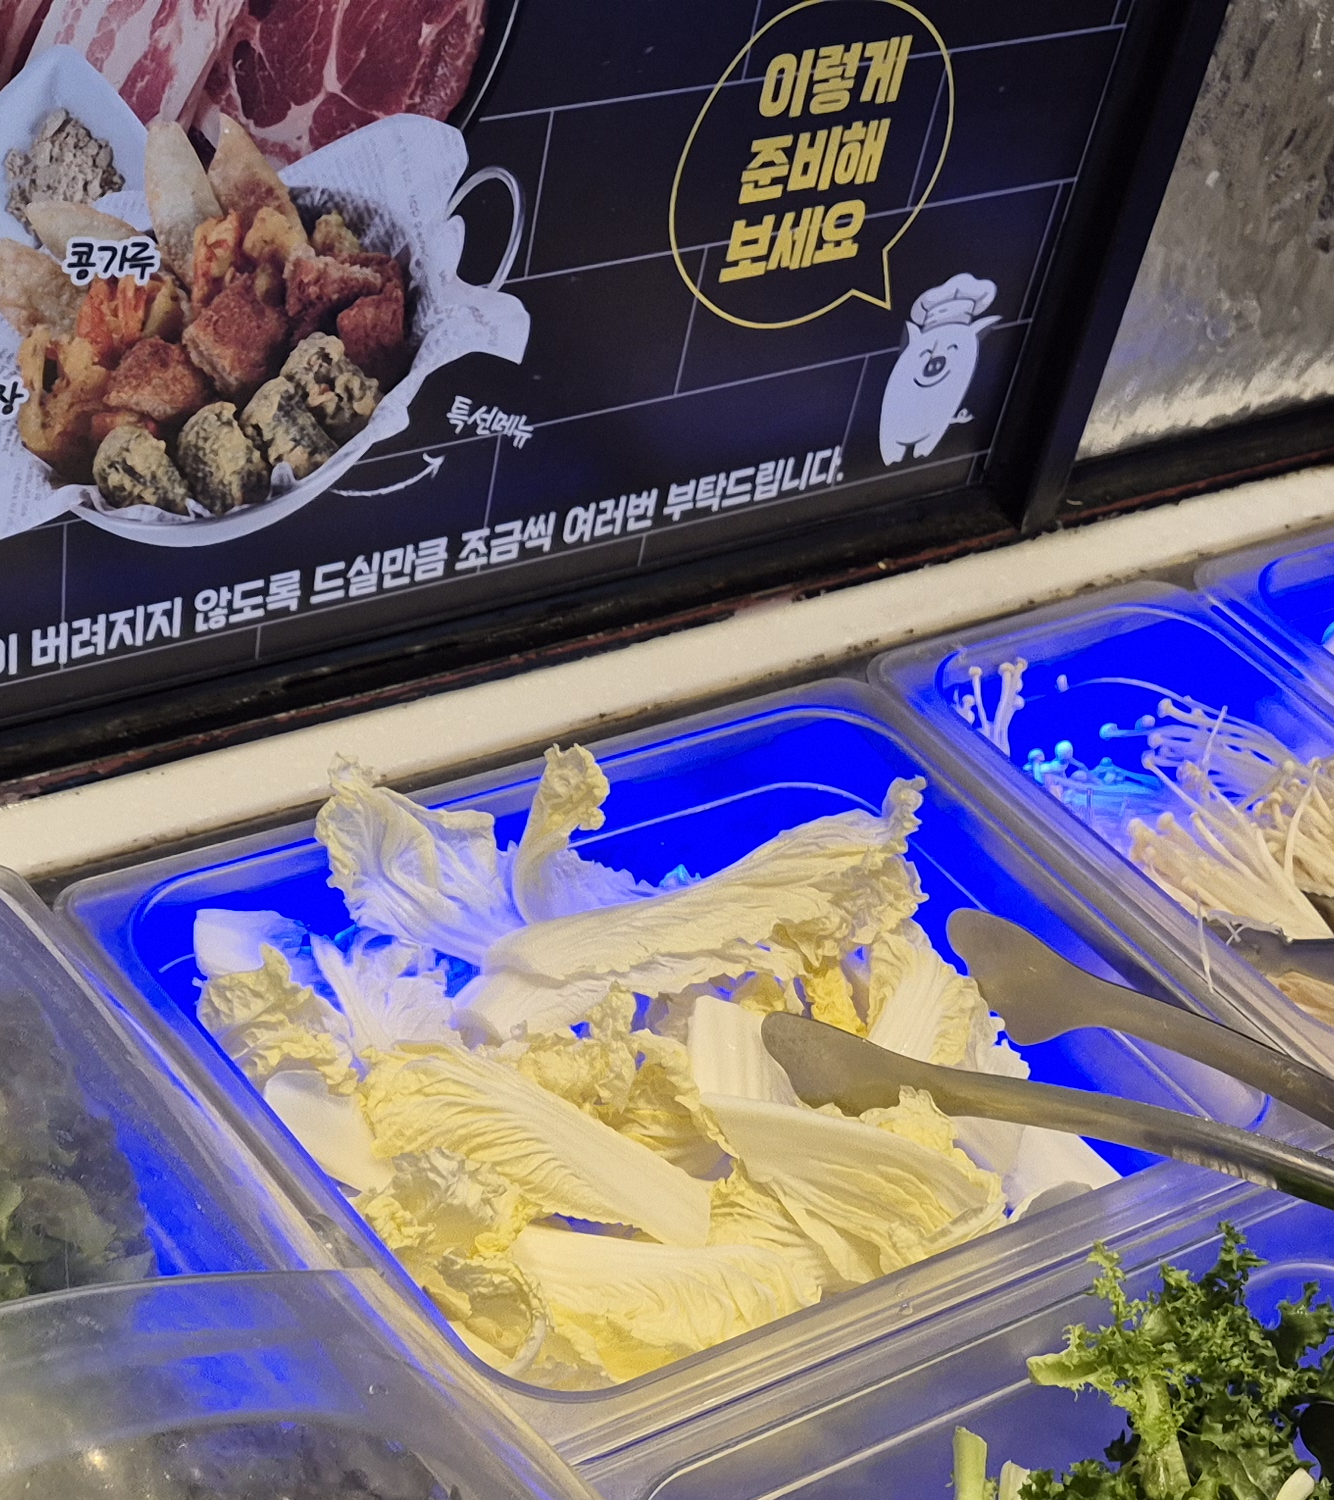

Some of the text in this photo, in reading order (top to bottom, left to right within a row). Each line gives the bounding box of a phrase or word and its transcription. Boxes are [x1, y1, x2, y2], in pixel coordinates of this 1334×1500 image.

[758, 36, 912, 118] 이렇게
[738, 119, 889, 204] 준비해
[66, 241, 158, 283] 콩가루
[719, 200, 866, 282] 보세요
[446, 395, 534, 449] 특선메뉴
[30, 598, 183, 670] 버려지지
[193, 570, 302, 632] 않도록
[309, 537, 449, 605] 드실만큼
[455, 511, 555, 572] 조금씩
[562, 485, 657, 544] 여러번
[664, 446, 844, 522] 부탁드립니다.
